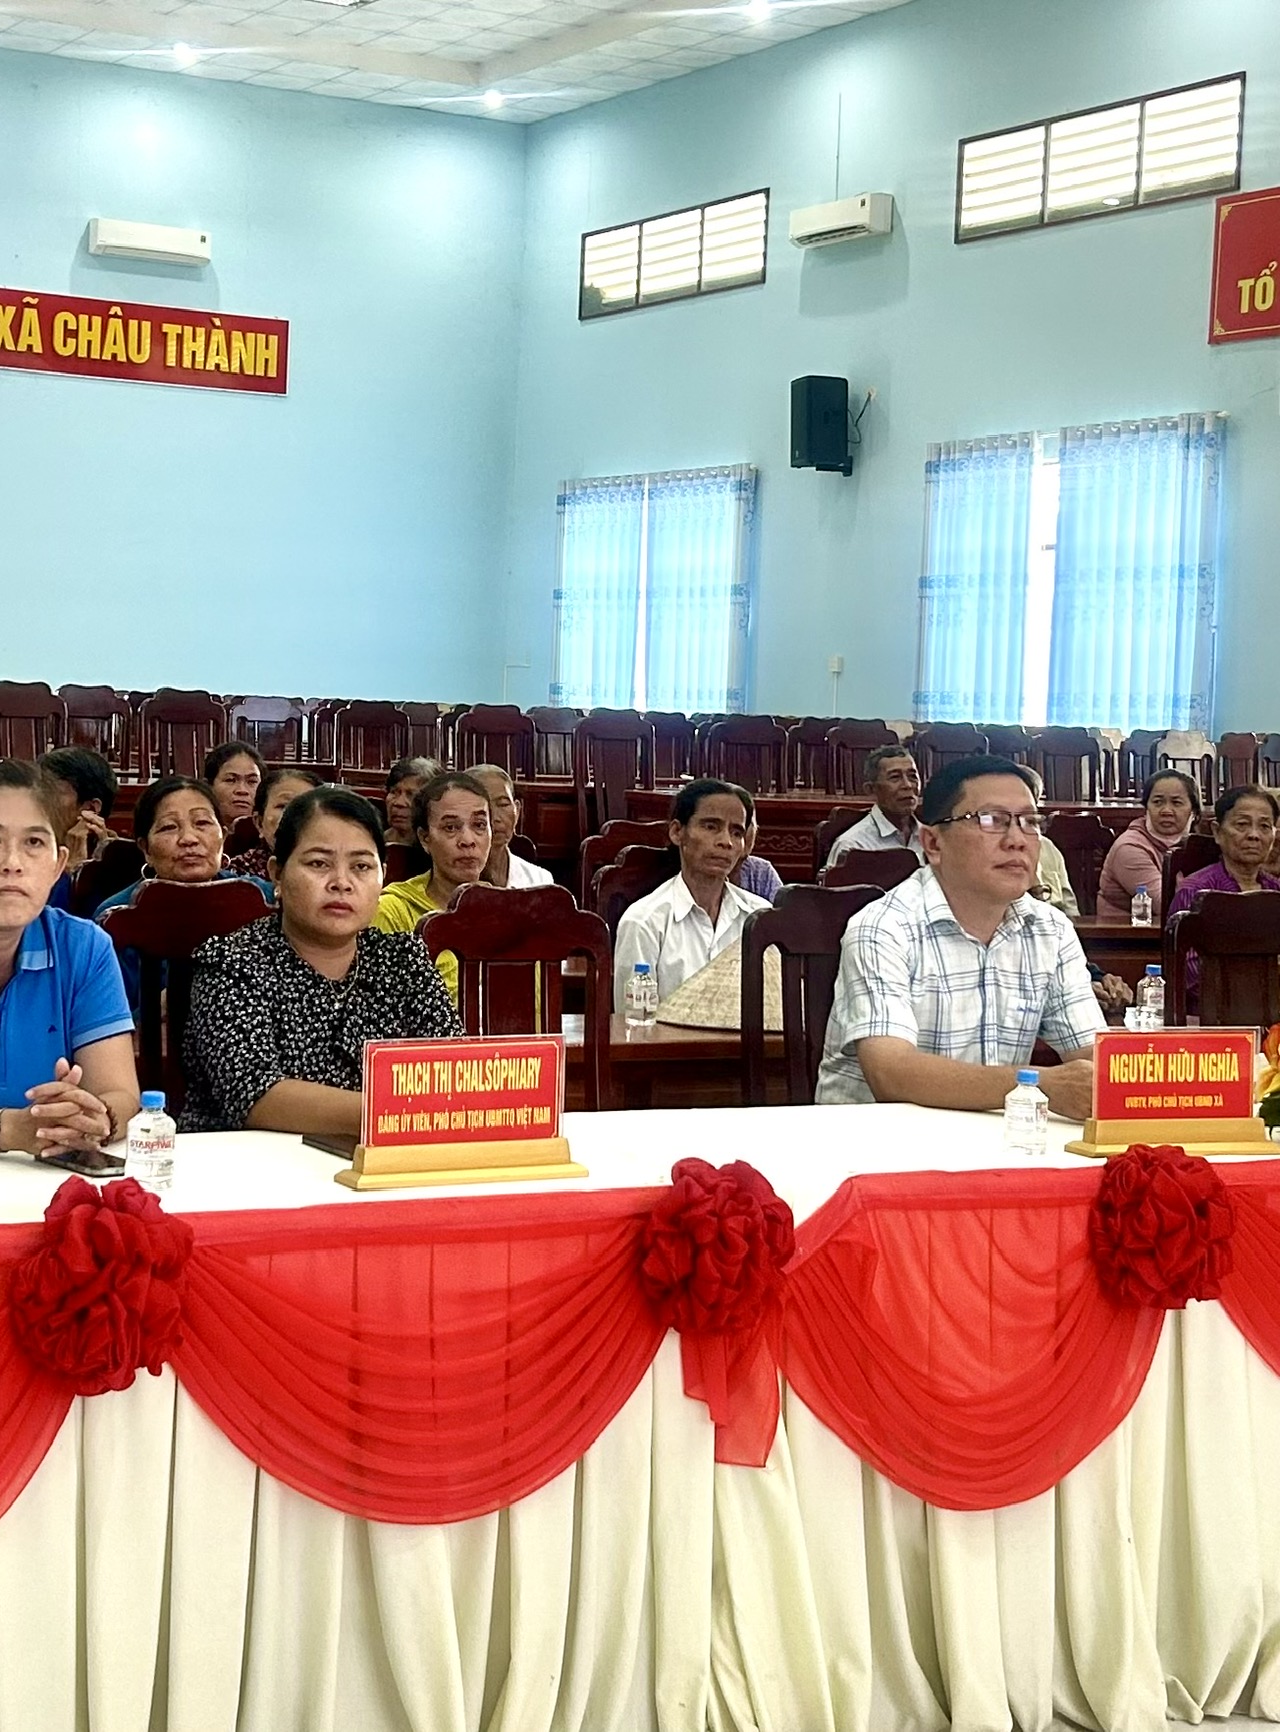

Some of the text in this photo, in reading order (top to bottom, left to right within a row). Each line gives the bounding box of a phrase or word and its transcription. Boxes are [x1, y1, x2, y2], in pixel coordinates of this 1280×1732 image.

[1237, 261, 1278, 314] TỔ
[52, 306, 152, 365] CHÂU
[162, 317, 279, 378] THÀNH
[391, 1052, 542, 1103] THẠCH THỊ CHALSÔPHIARY
[1109, 1043, 1239, 1083] NGUYỄN HỮU NGHĨA
[434, 1108, 449, 1131] PHÓ
[516, 1104, 532, 1130] VIỆT
[533, 1107, 551, 1125] NAM
